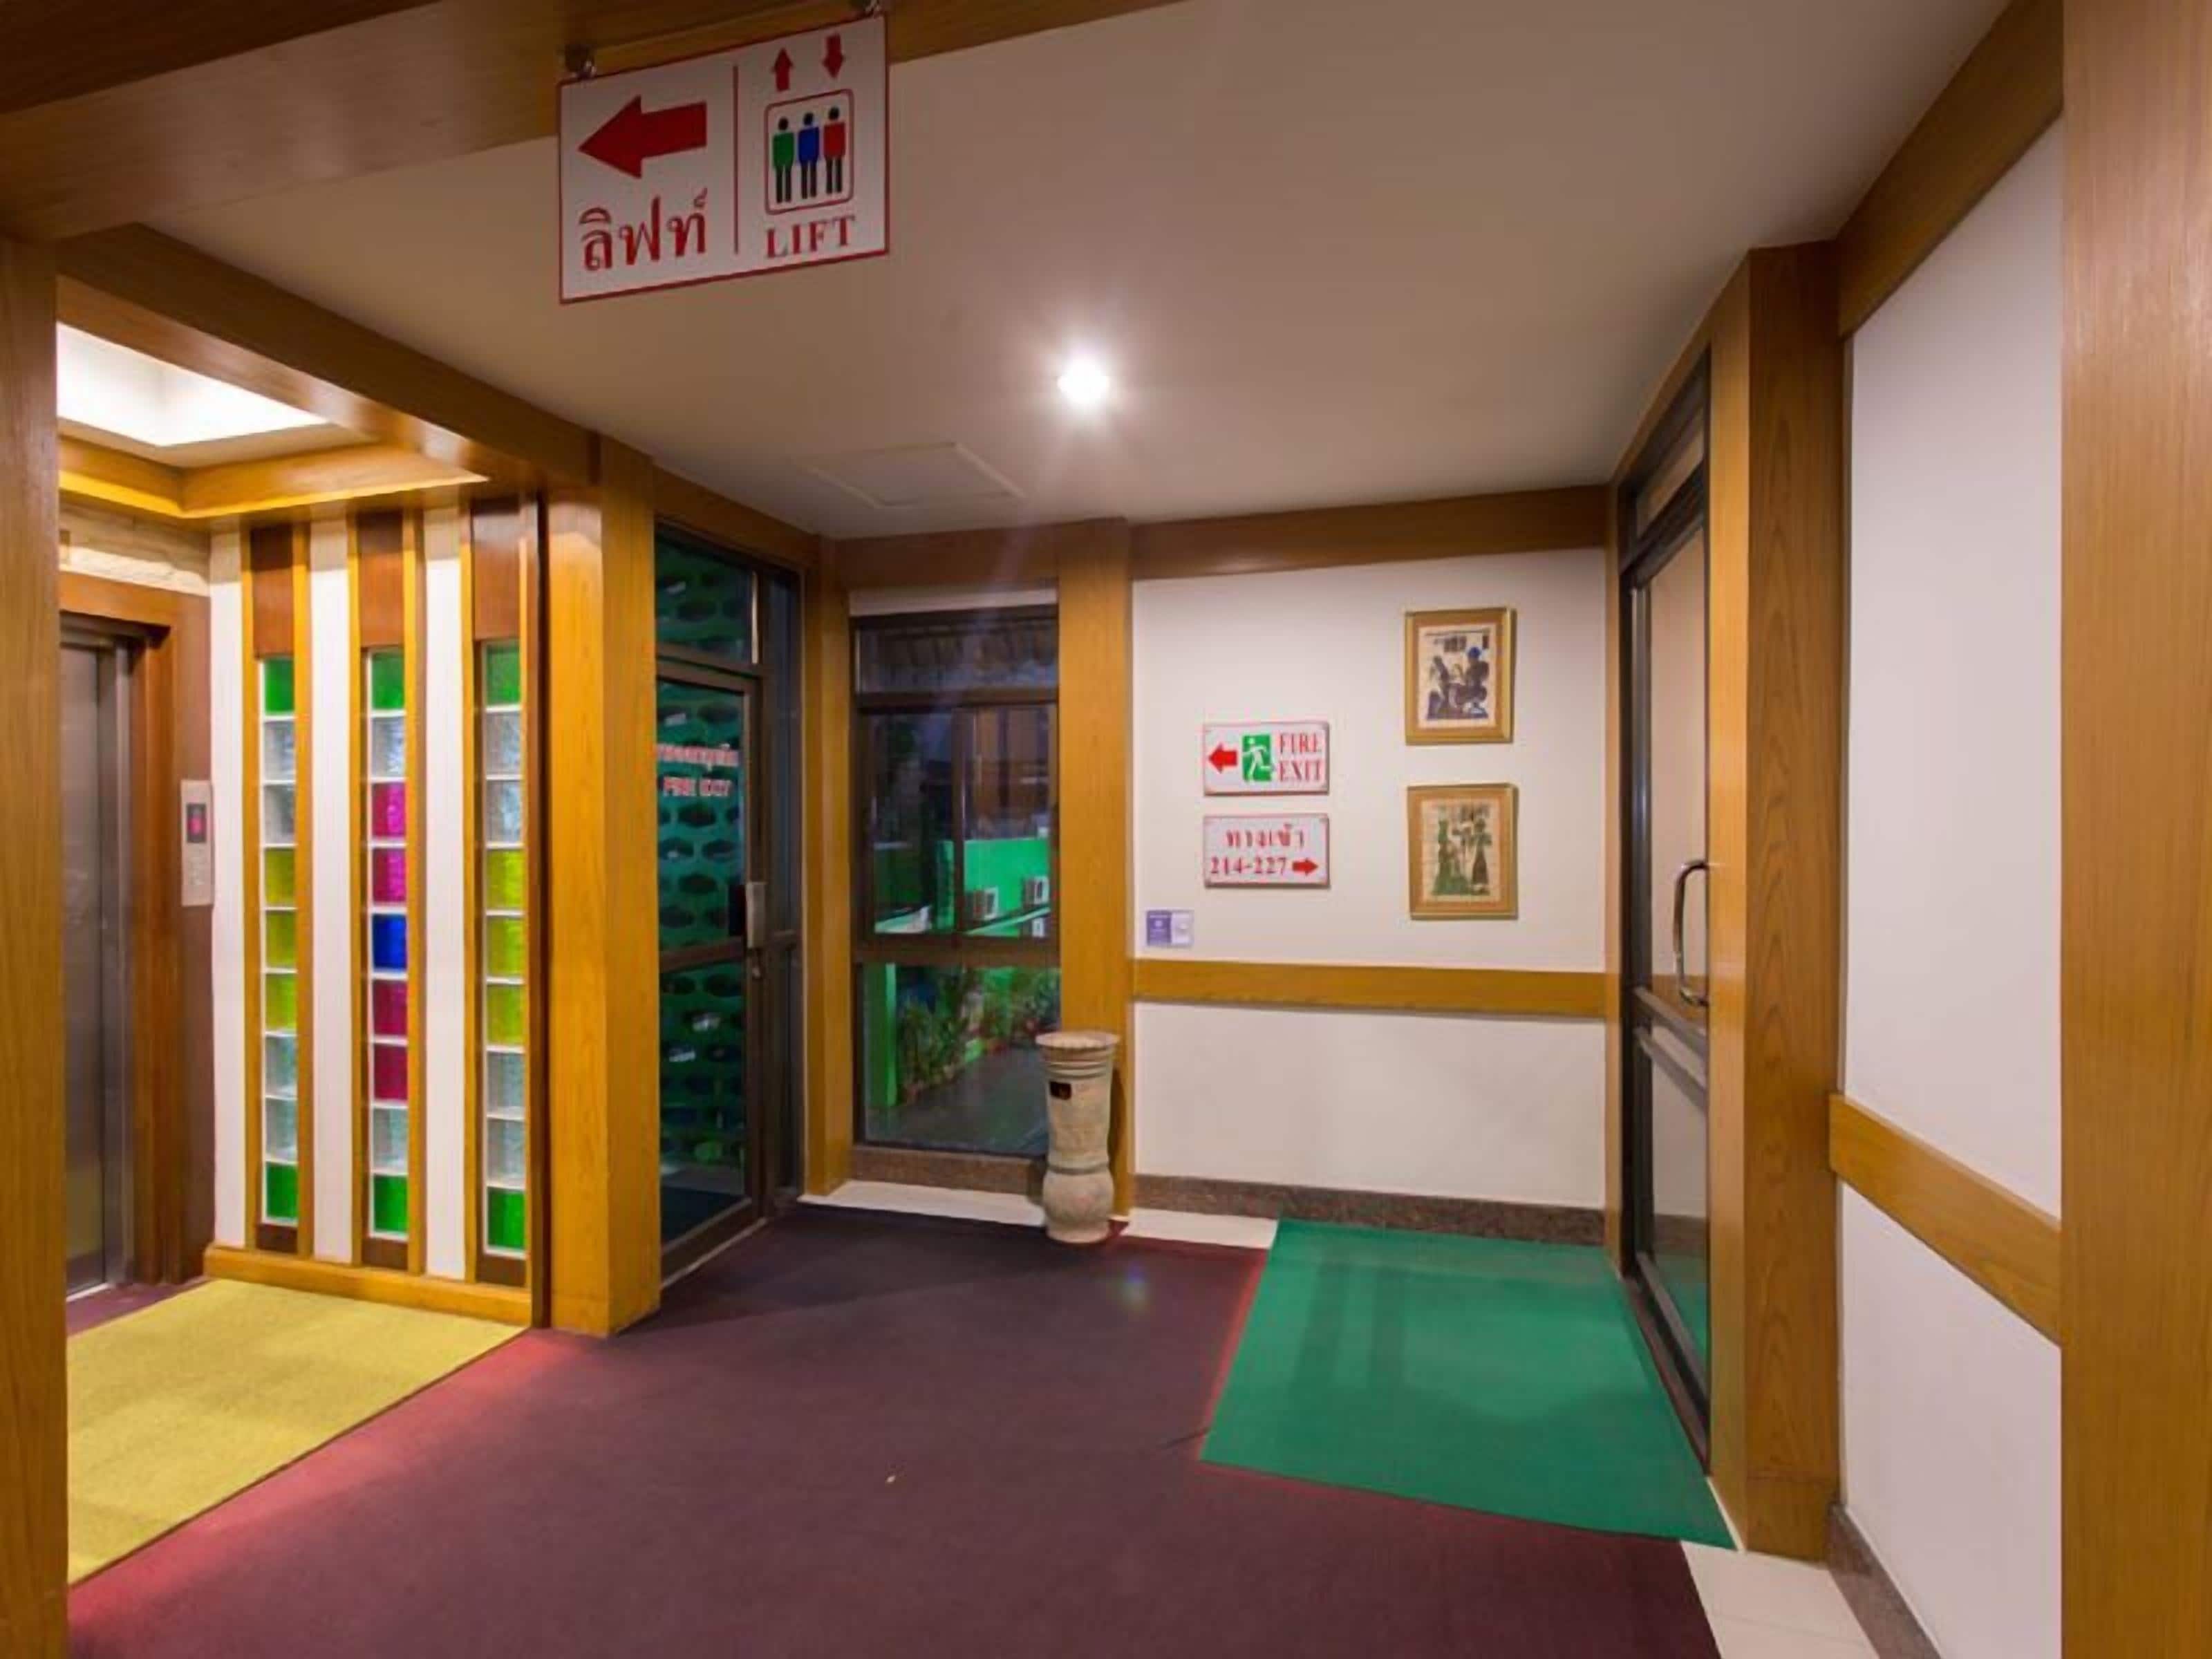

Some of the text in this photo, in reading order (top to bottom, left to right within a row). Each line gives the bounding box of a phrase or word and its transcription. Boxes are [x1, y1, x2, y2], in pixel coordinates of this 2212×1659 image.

[578, 188, 708, 272] ลิฟท์
[766, 215, 856, 259] LIFT
[1280, 733, 1322, 754] FIRE
[1280, 760, 1321, 782] EXIT
[1210, 856, 1288, 875] 214-227
